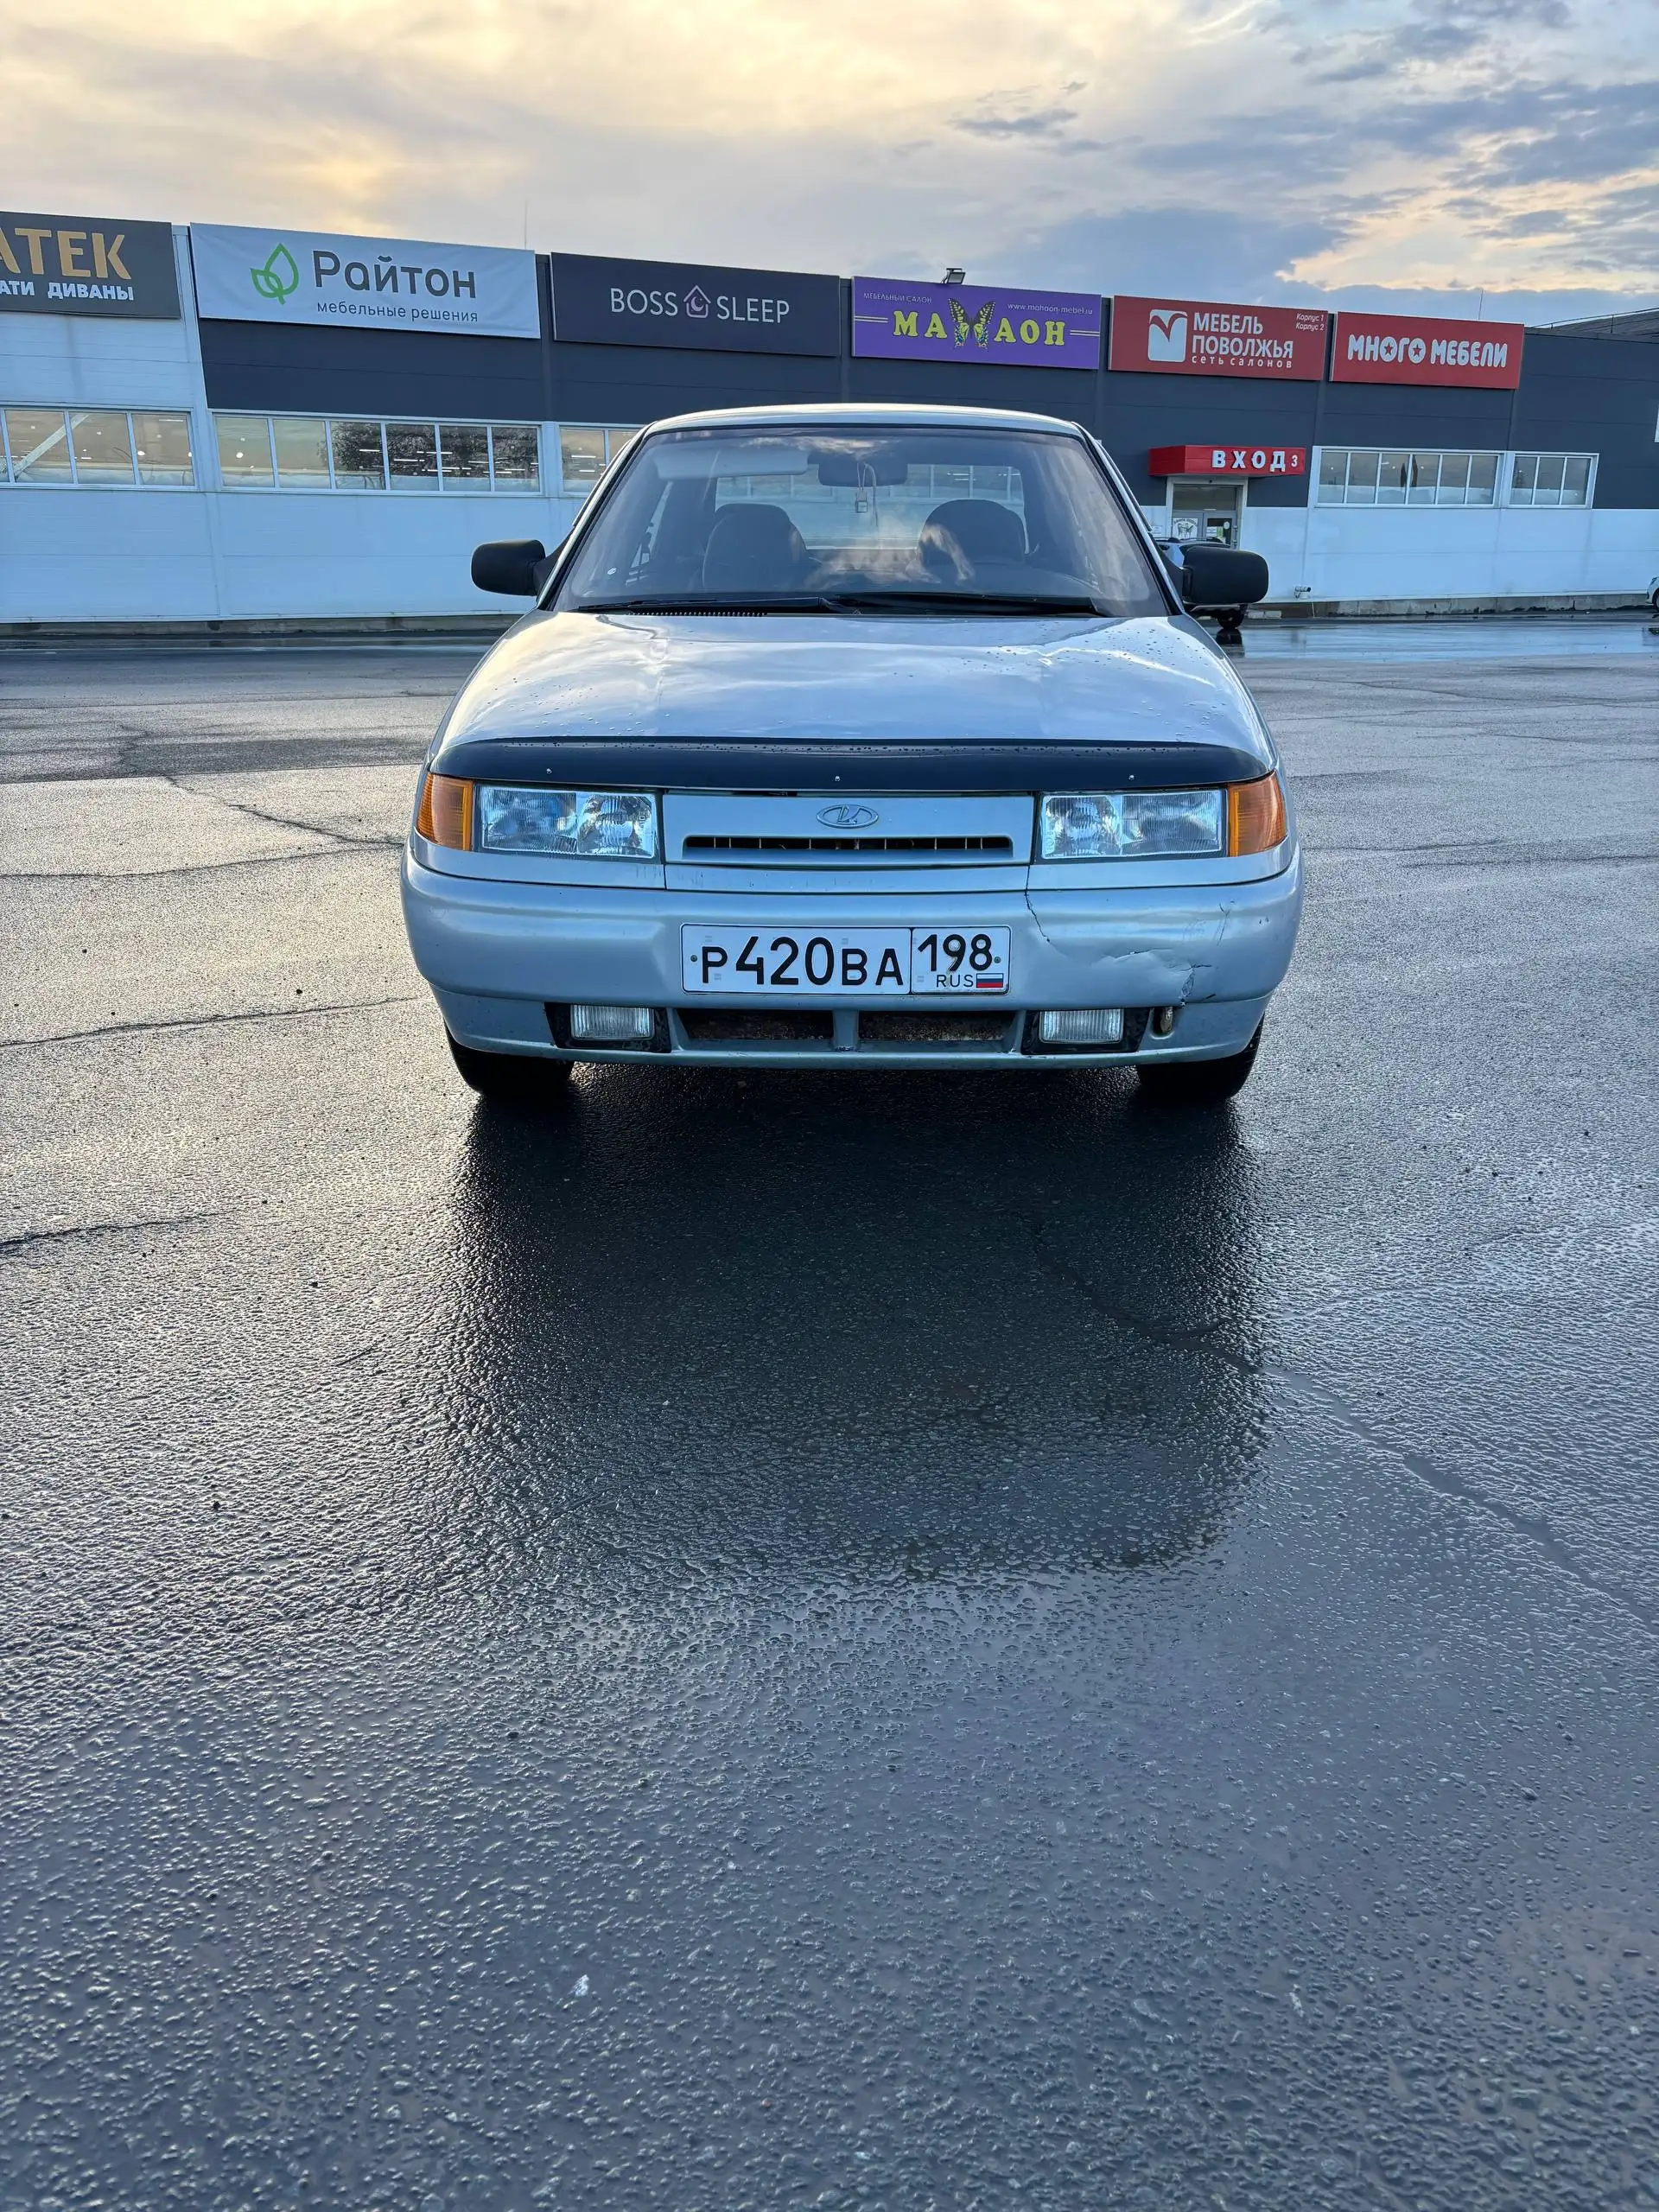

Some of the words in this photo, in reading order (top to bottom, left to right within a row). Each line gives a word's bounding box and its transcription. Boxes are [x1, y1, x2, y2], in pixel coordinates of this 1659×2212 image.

[313, 251, 476, 298] Райтон
[48, 282, 134, 301] ДИВАНЫ
[317, 301, 406, 318] мебельные
[411, 307, 478, 322] решения
[610, 288, 678, 316] BOSS
[716, 296, 790, 323] SLEEP
[1193, 312, 1263, 334] МЕБЕЛЬ
[1296, 313, 1319, 322] Корпус
[1296, 321, 1319, 331] Корпус
[1192, 335, 1294, 359] ПОВОЛЖЬЯ
[1347, 334, 1427, 364] МНОГО
[1430, 339, 1508, 368] МЕБЕЛИ
[1192, 355, 1224, 365] сеть
[1230, 358, 1293, 368] салонов
[1211, 449, 1286, 472] ВХОД
[1291, 454, 1298, 467] 3
[917, 933, 993, 972] 198
[936, 974, 974, 988] RUS
